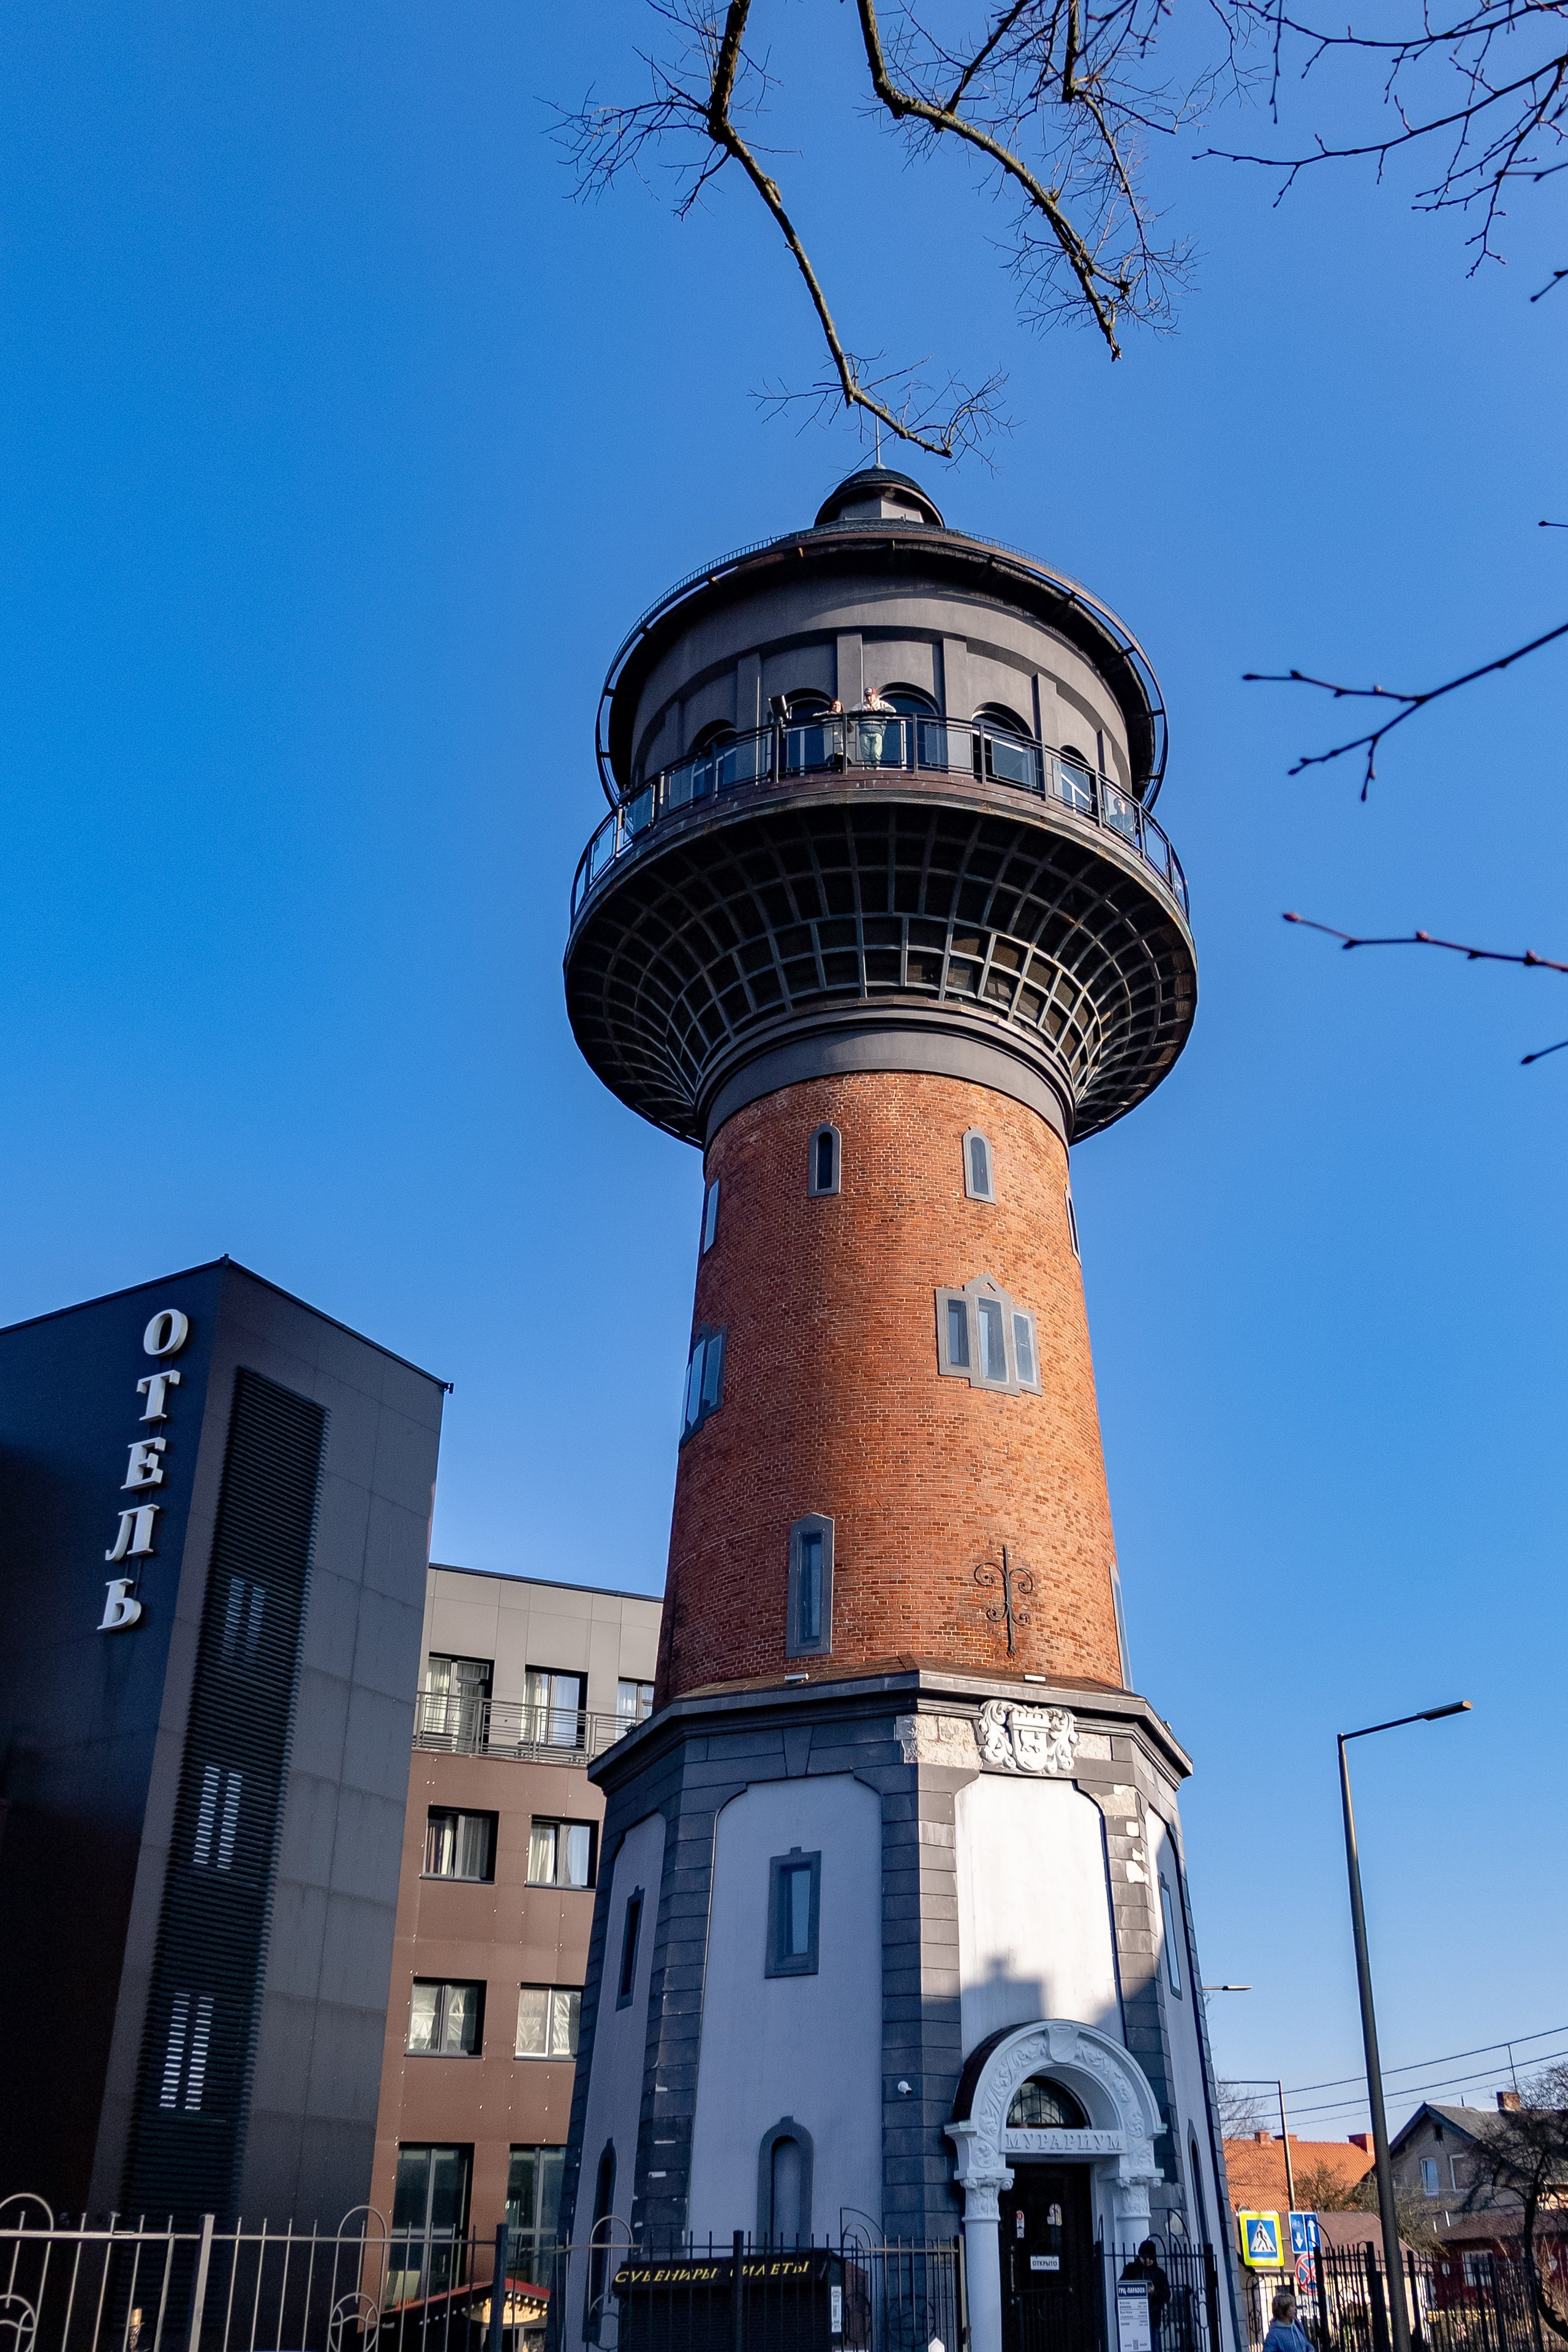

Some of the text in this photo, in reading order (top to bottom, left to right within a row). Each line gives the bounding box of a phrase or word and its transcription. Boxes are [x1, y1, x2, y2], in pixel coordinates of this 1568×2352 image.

[97, 1308, 189, 1630] ОТЕЛЬ
[1005, 2133, 1123, 2150] МУРАРИУМ
[614, 2260, 810, 2283] СУВЕНИРЫ ИЛЕТЫ
